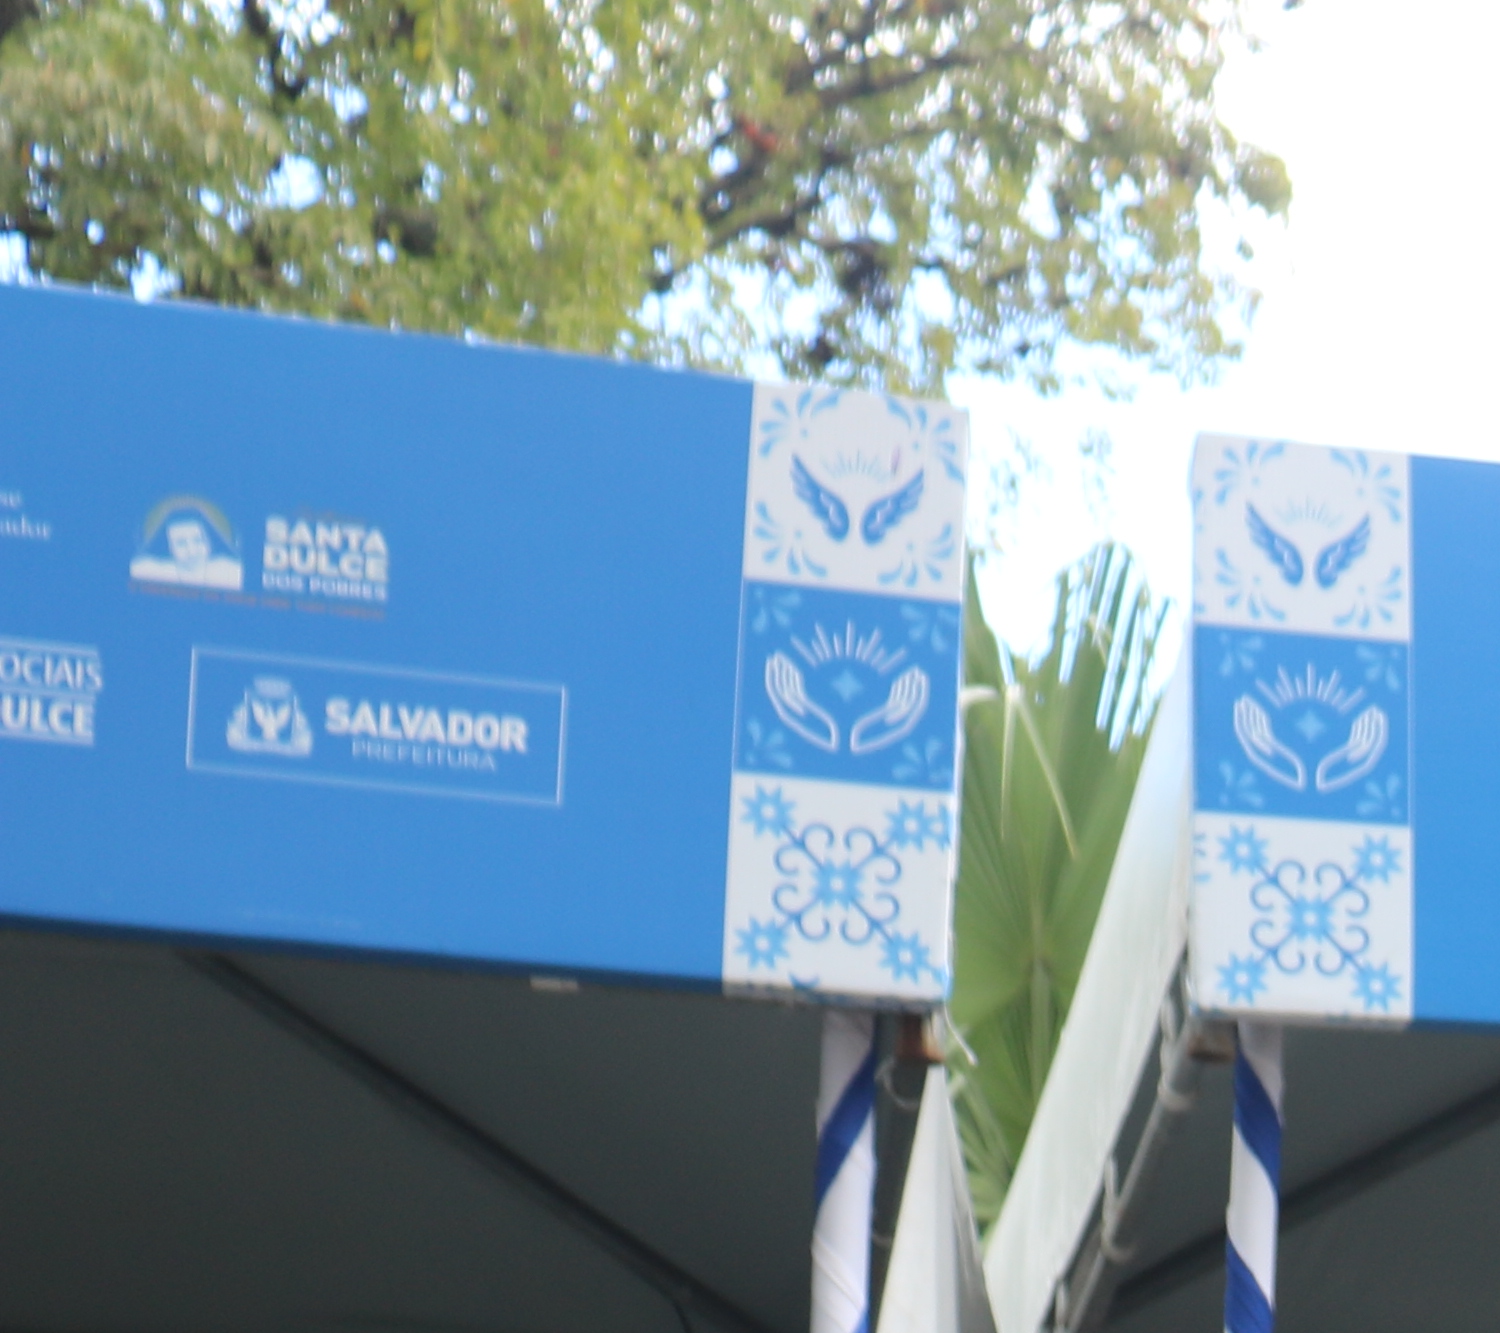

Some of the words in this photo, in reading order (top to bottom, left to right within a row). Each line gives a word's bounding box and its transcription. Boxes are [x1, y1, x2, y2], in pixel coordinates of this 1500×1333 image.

[265, 516, 387, 556] SANTA
[264, 544, 388, 581] DULCE
[325, 697, 528, 753] SALVADOR
[352, 739, 497, 773] PREFEITURA
